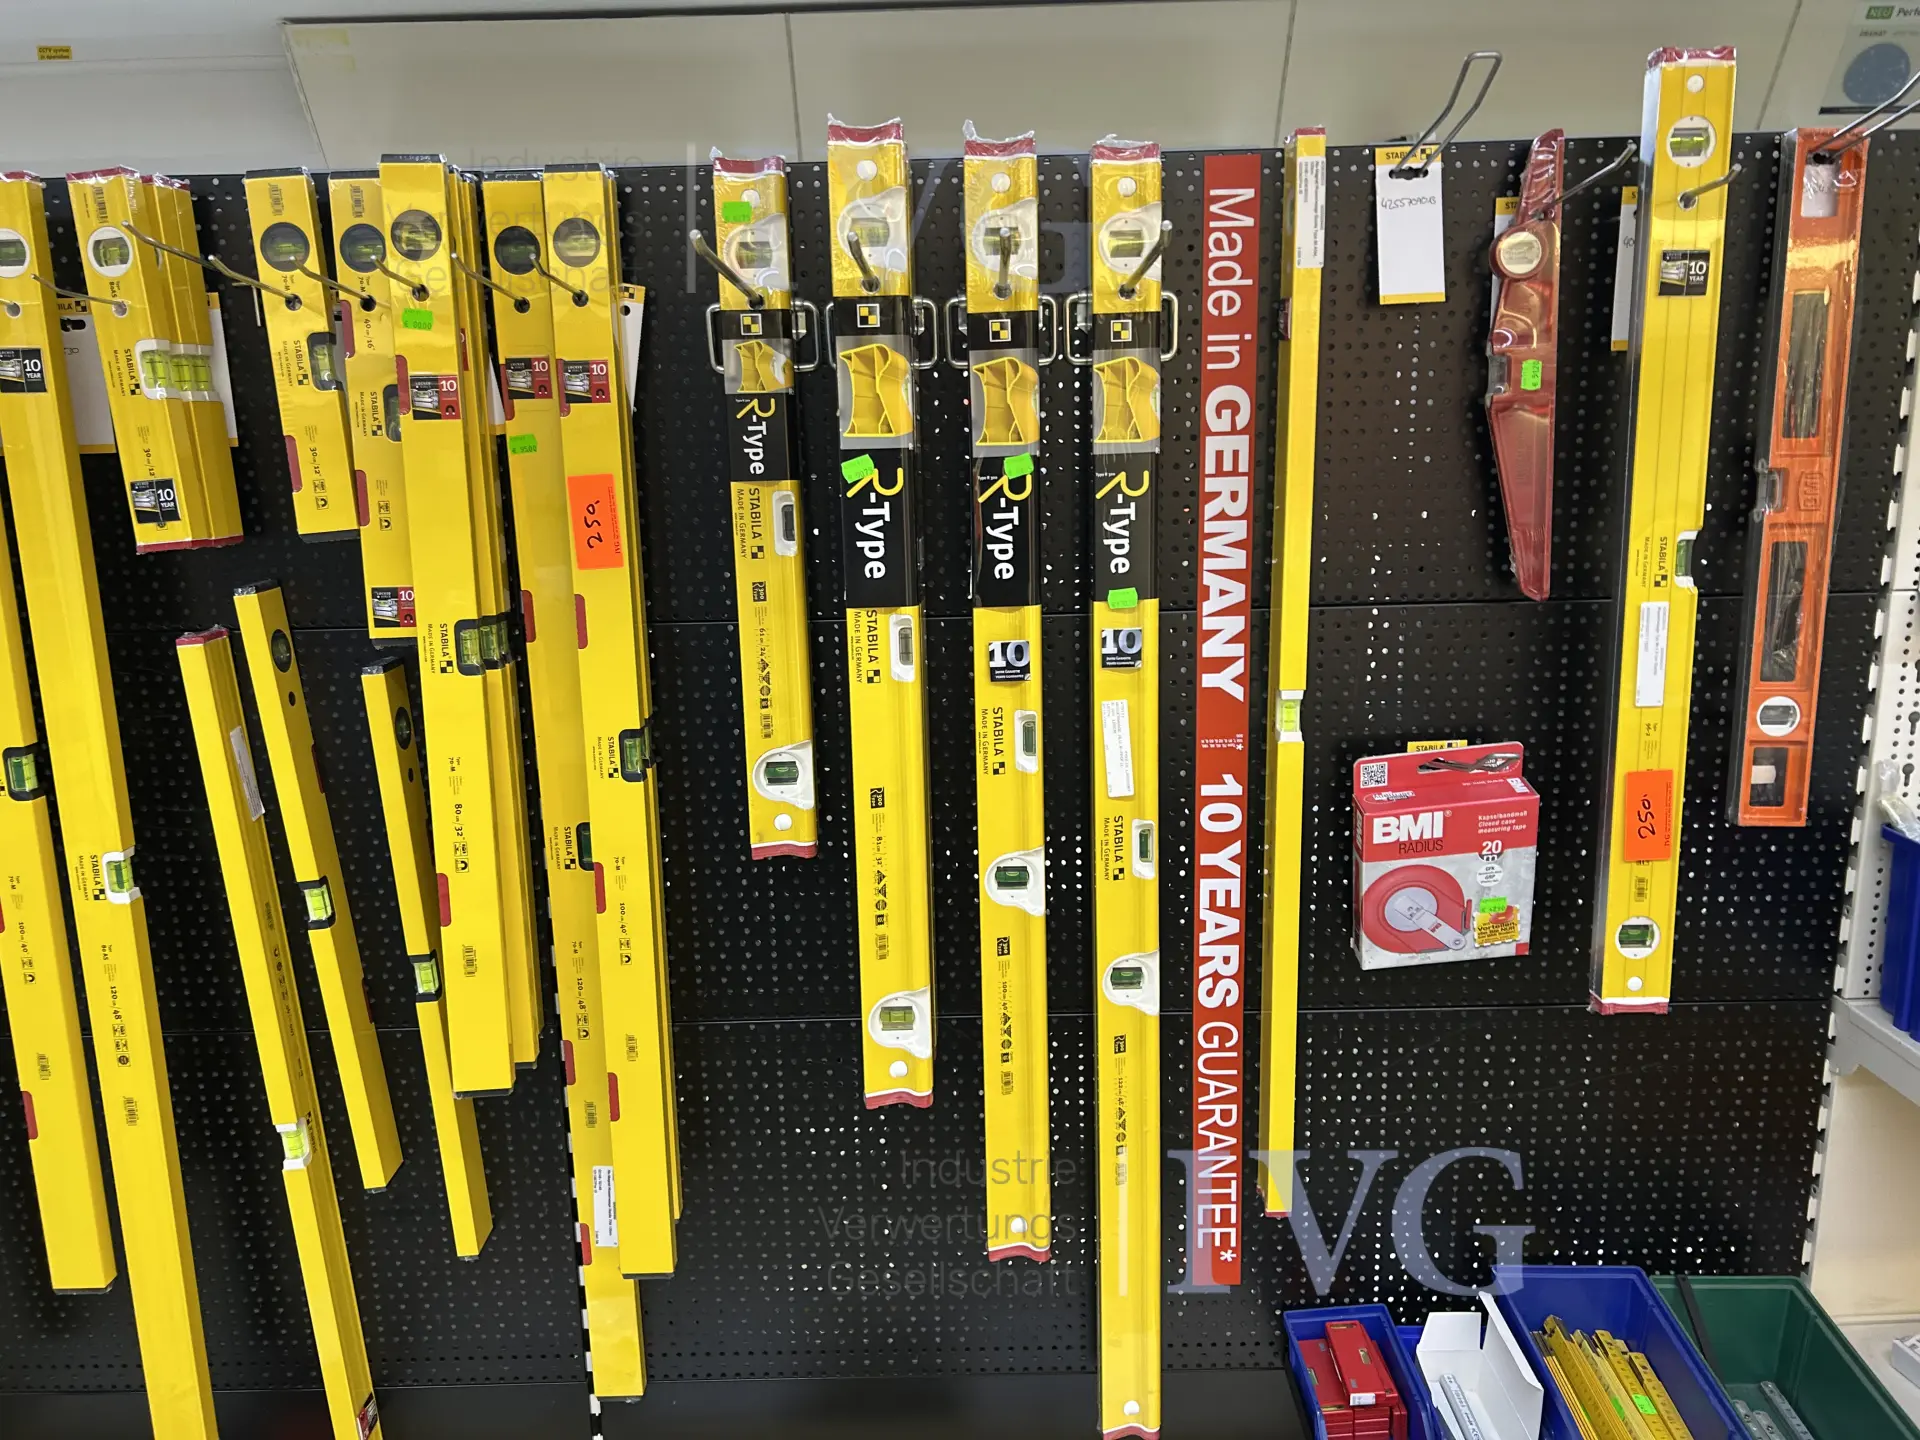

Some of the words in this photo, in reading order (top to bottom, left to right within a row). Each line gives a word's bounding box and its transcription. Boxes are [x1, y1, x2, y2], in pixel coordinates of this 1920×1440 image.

[1207, 188, 1255, 317] Made
[1689, 261, 1706, 274] 10
[23, 359, 41, 372] 10
[124, 349, 136, 381] STABILA
[294, 340, 304, 371] STABILA
[533, 360, 548, 372] 10
[1206, 333, 1252, 370] in
[440, 380, 457, 391] 10
[591, 364, 606, 375] 10
[370, 392, 380, 422] STABILA
[157, 489, 174, 501] 10
[749, 488, 762, 539] STABILA
[846, 468, 904, 579] R-Type
[1095, 470, 1149, 574] R-Type
[740, 521, 748, 559] GERMANY
[1201, 384, 1251, 702] GERMANY
[1658, 537, 1667, 571] STABILA
[400, 590, 414, 601] 10
[439, 623, 449, 657] STABILA
[866, 610, 879, 663] STABILA
[1101, 629, 1142, 654] 10
[855, 646, 863, 683] GERMANY
[989, 641, 1030, 668] 10
[993, 707, 1004, 756] STABILA
[607, 737, 616, 765] STABILA
[982, 741, 990, 775] GERMANY
[1199, 773, 1244, 822] 10
[564, 826, 573, 856] STABILA
[1114, 815, 1124, 863] STABILA
[1372, 811, 1444, 845] BMI
[1398, 839, 1443, 854] RADIUS
[1482, 840, 1502, 854] 20
[90, 855, 100, 886] STABILA
[1197, 842, 1241, 1010] YEARS
